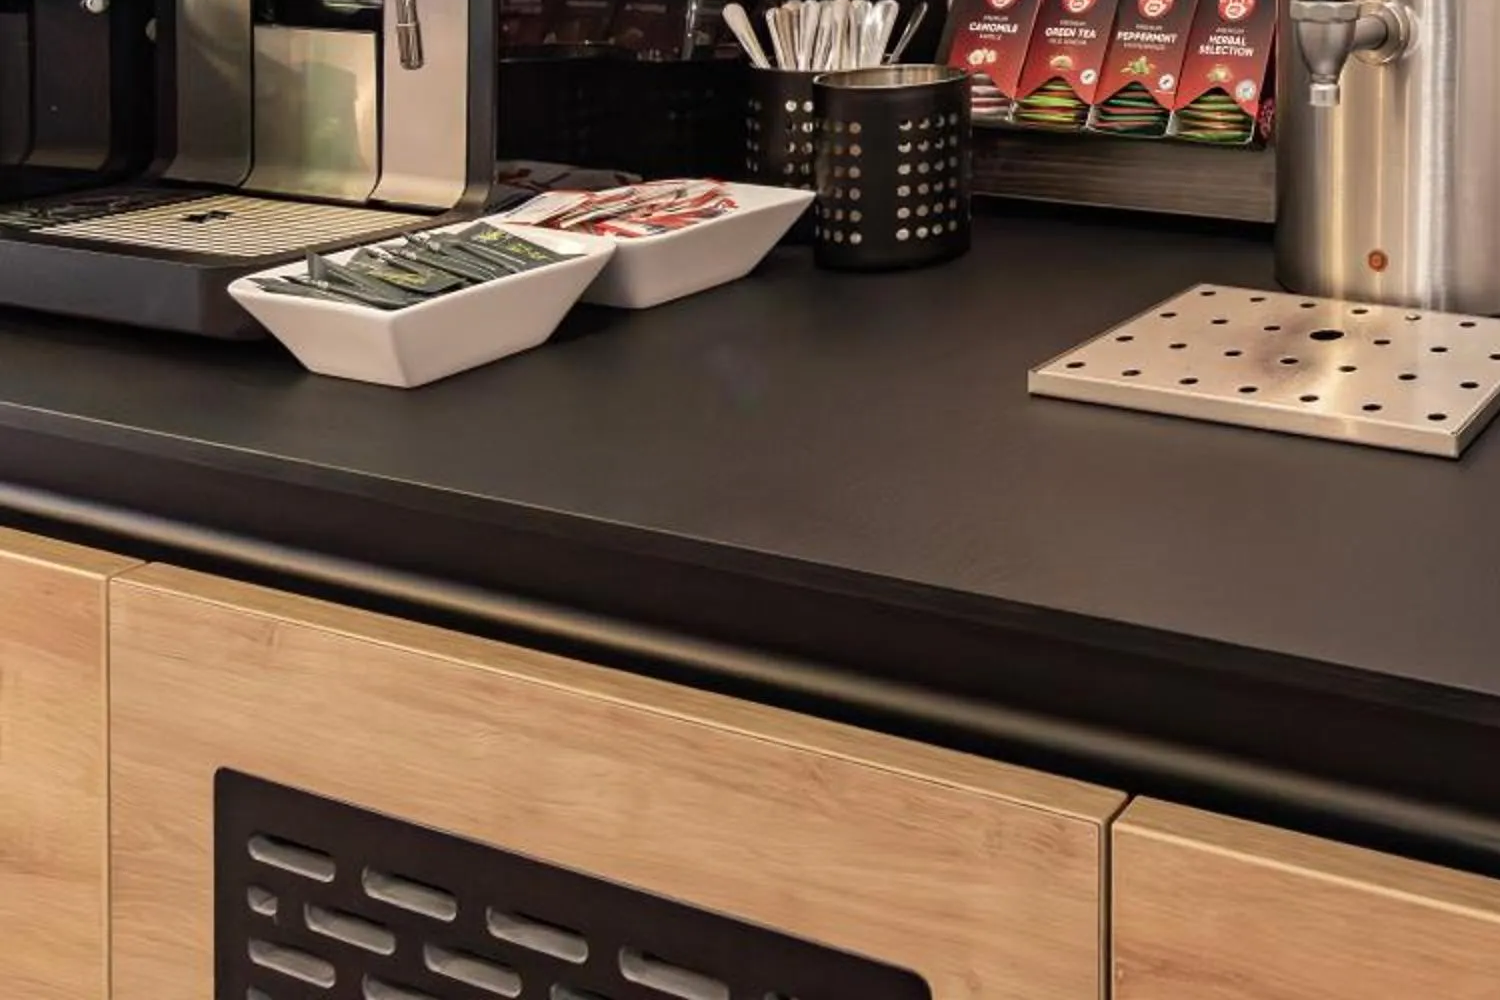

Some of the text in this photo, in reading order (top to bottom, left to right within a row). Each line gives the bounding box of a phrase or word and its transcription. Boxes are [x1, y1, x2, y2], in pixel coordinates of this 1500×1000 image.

[969, 22, 1018, 33] CAMOMILE
[1045, 27, 1096, 39] GREEN TEA
[1117, 31, 1178, 44] PEPPERMINT
[1209, 35, 1247, 47] HERBAL
[1199, 45, 1254, 57] SELECTION
